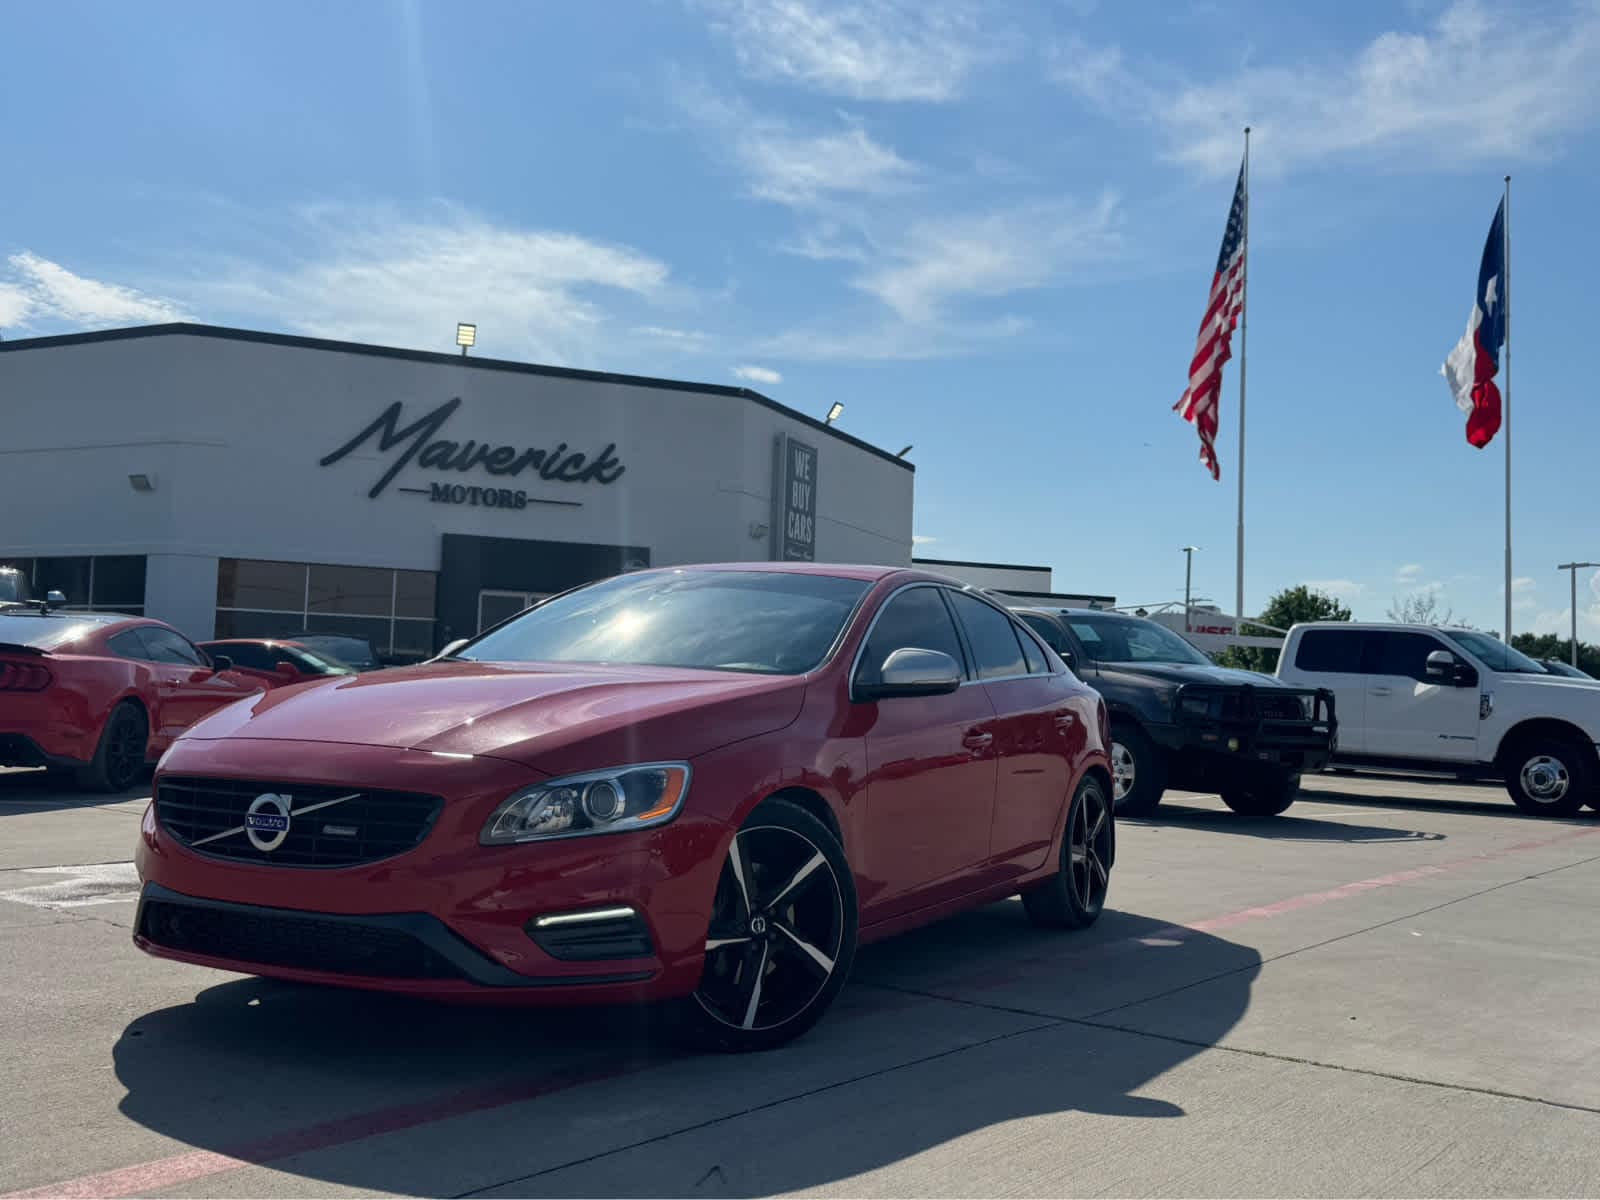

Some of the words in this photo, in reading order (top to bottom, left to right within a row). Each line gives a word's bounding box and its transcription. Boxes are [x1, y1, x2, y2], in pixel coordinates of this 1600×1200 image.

[319, 397, 626, 498] Maverick
[794, 448, 810, 480] WE
[431, 482, 528, 509] MOTORS
[792, 480, 810, 511] BUY
[788, 511, 812, 543] CARS
[248, 816, 284, 827] VOLVO
